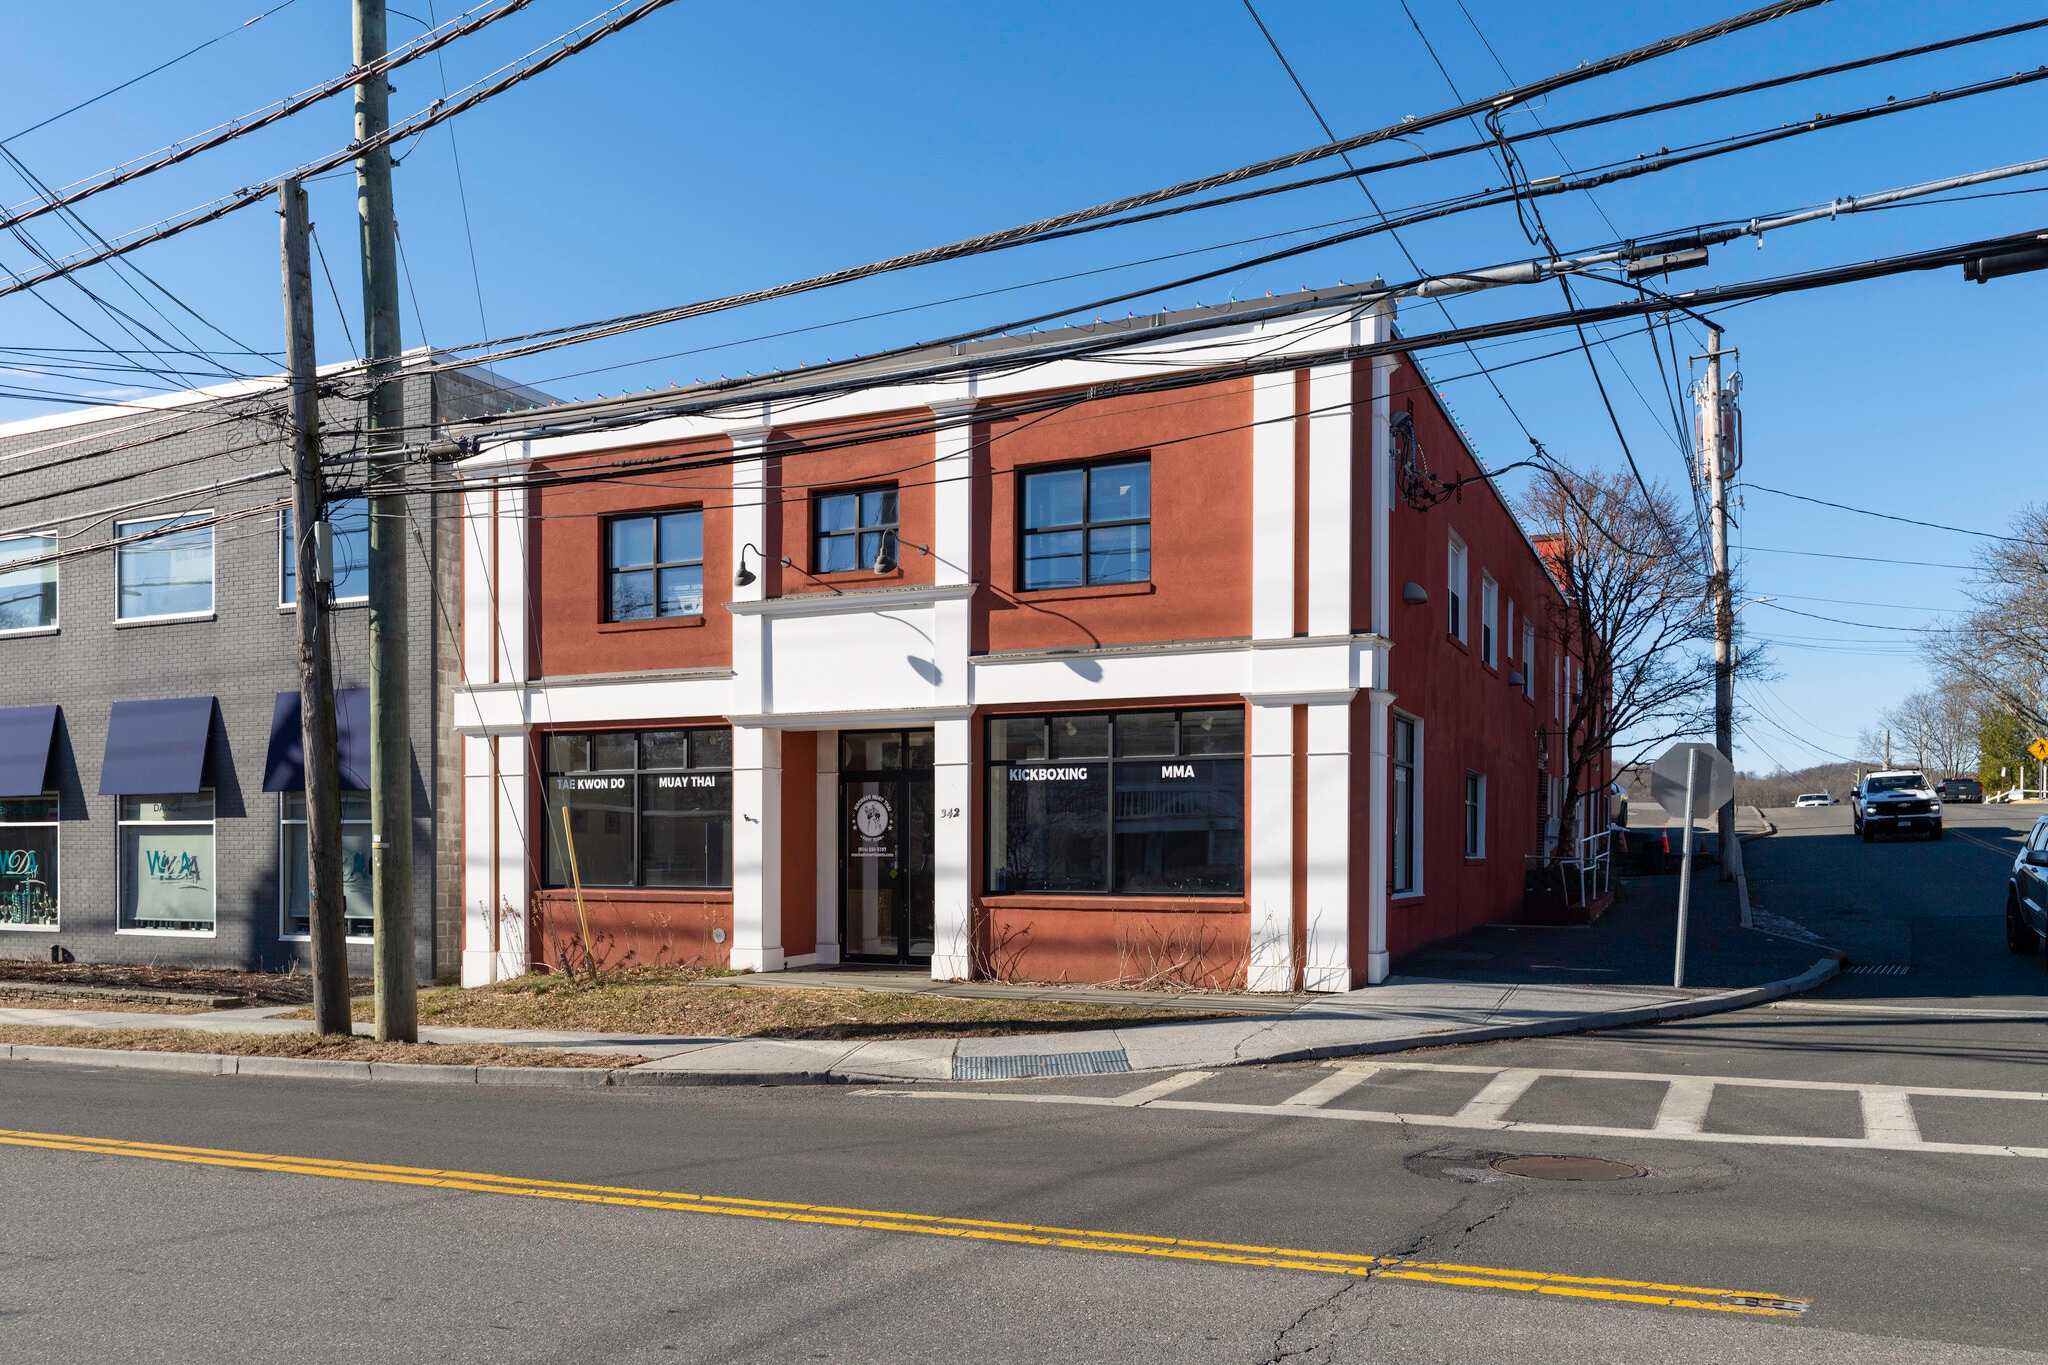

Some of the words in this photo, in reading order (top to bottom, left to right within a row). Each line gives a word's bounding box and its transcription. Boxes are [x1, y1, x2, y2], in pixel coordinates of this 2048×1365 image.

[1009, 767, 1088, 781] KICKBOXING
[1161, 764, 1195, 778] MMA
[556, 779, 576, 790] TAE
[577, 778, 609, 790] KWON
[610, 777, 625, 789] DO
[658, 776, 689, 788] MUAY
[690, 775, 716, 787] THAI
[153, 803, 183, 812] DANCE
[941, 807, 960, 818] 342
